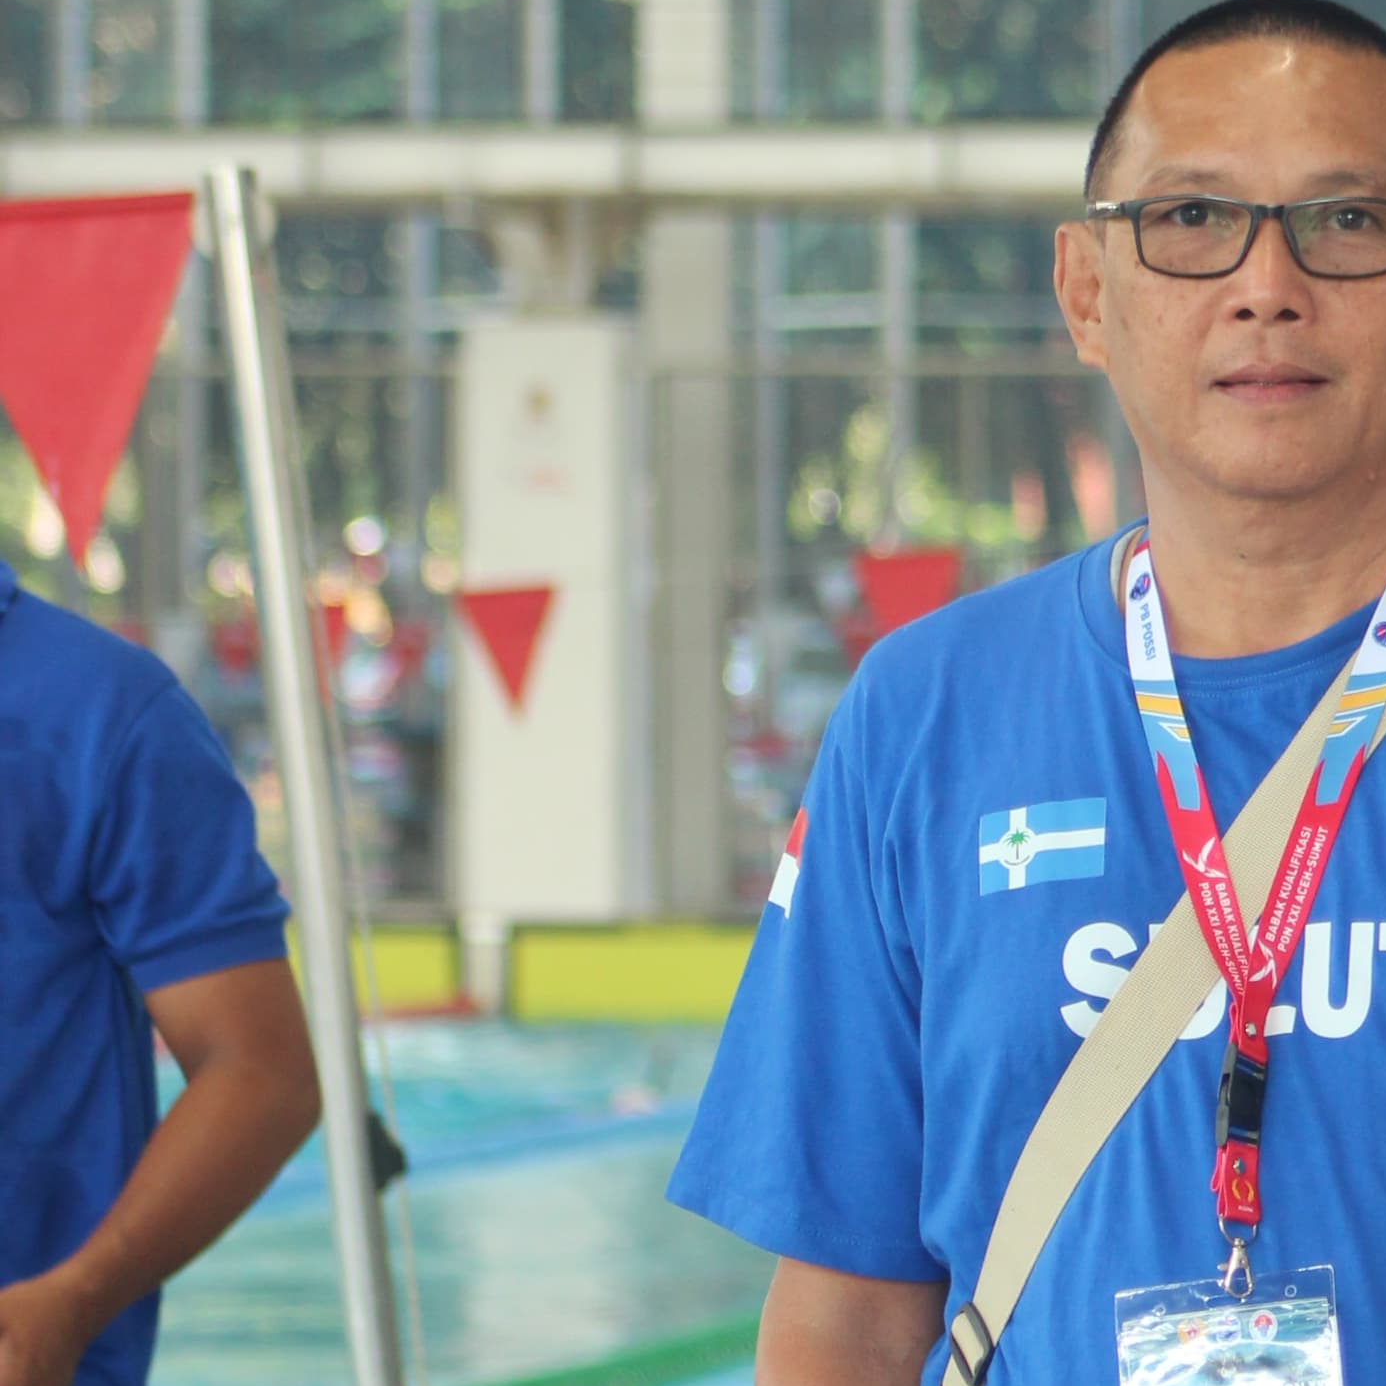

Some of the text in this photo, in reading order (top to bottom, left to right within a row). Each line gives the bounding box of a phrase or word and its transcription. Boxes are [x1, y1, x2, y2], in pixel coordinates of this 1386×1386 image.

[1139, 603, 1157, 662] PB POSSI
[1199, 882, 1214, 911] PON
[1206, 907, 1217, 927] XXI
[1265, 827, 1313, 943] BABAK KUALIFIKASI
[1277, 826, 1329, 953] PON XXI ACEH-SUMUT
[1215, 882, 1249, 980] BABAK KUALIFIK
